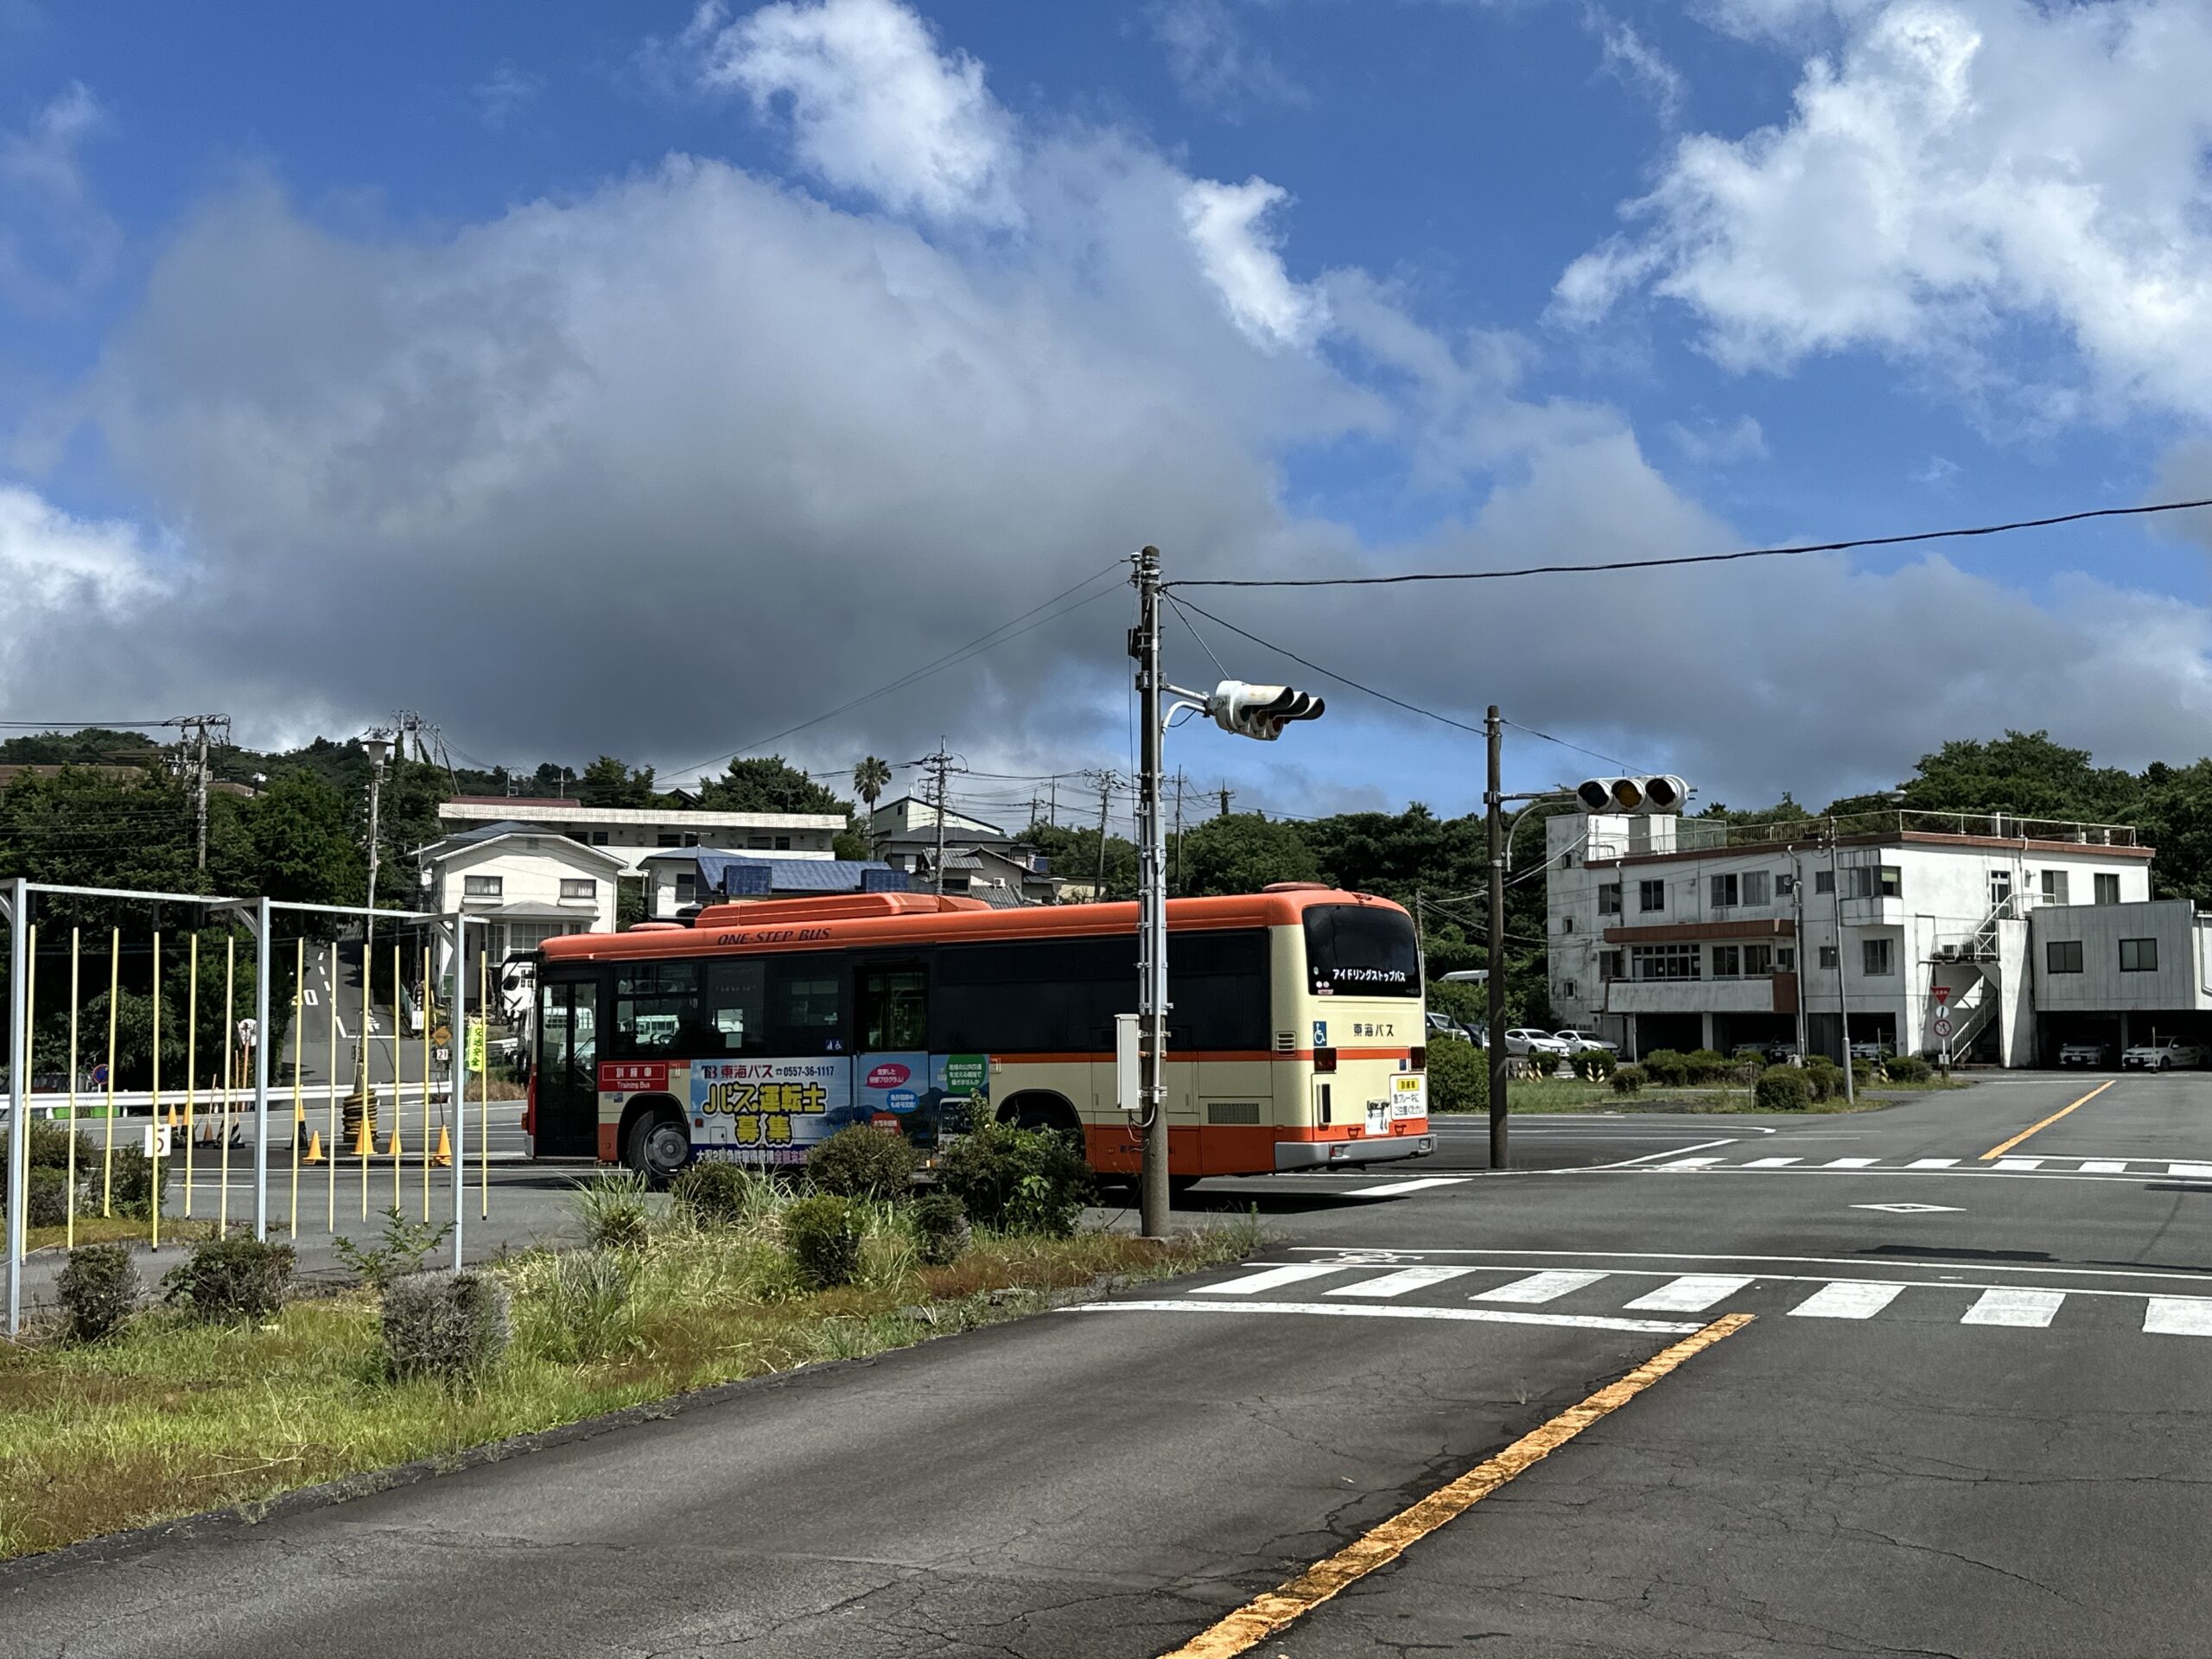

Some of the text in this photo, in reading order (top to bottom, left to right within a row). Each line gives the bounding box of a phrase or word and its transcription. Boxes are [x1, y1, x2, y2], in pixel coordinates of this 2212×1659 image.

[718, 927, 832, 945] ONE-STEP BUS
[1332, 969, 1406, 982] アイドリングストップバス
[1353, 1023, 1395, 1037] 東海バス
[437, 1051, 448, 1059] 21
[721, 1064, 774, 1079] 東海バス
[783, 1065, 835, 1077] 0557-36-1117
[702, 1080, 826, 1115] バス運転士
[734, 1114, 793, 1146] 募集
